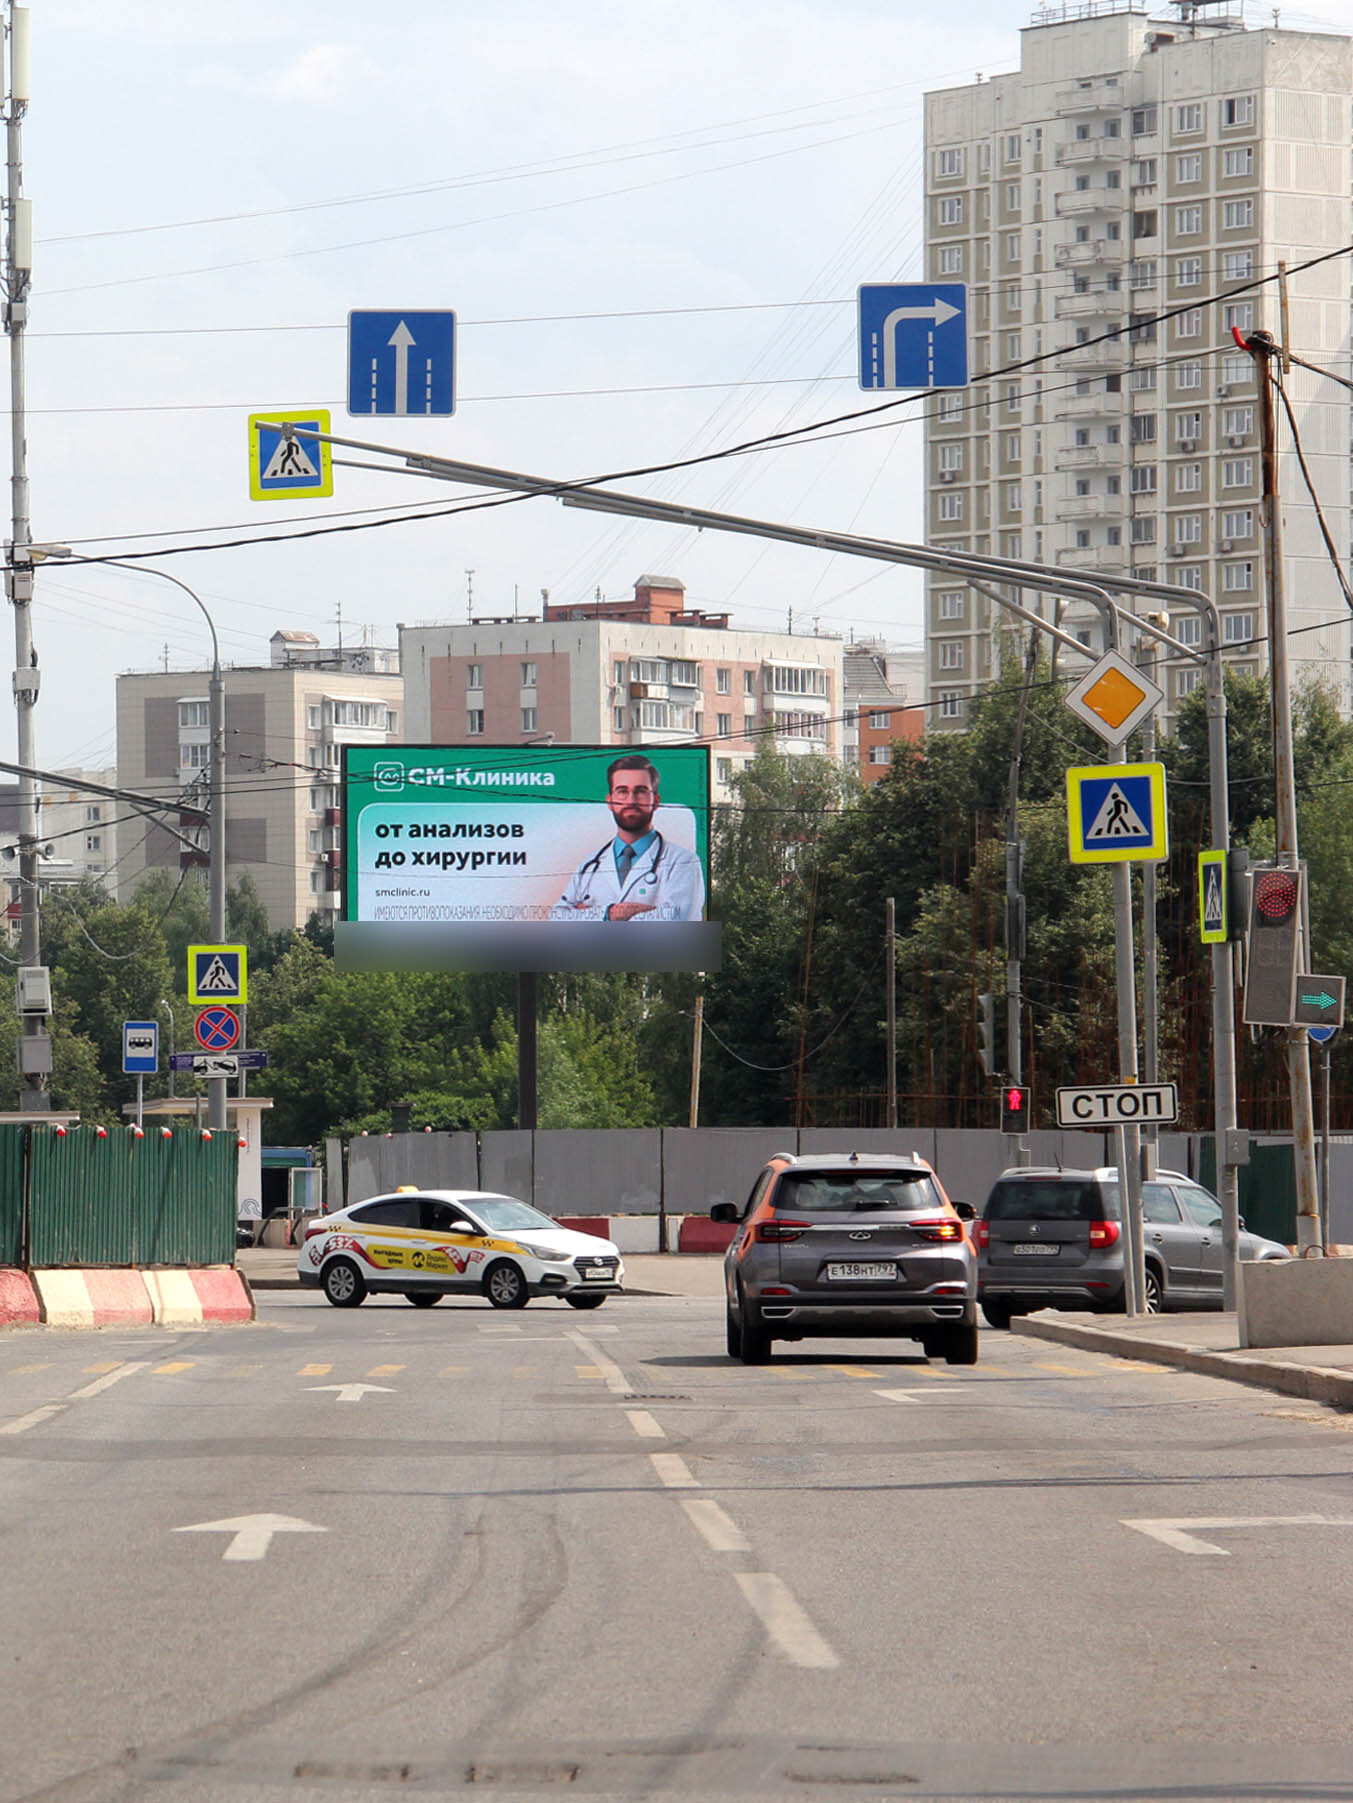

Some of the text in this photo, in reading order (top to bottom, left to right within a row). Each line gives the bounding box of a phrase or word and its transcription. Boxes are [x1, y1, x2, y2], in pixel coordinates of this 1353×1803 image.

[408, 767, 556, 786] СМ-Клиника
[375, 824, 524, 838] от анализов
[375, 852, 527, 870] до хирургии
[375, 887, 431, 897] smclinic.ru
[374, 904, 408, 921] ИМЕЮТСЯ
[1072, 1092, 1162, 1118] СТОП
